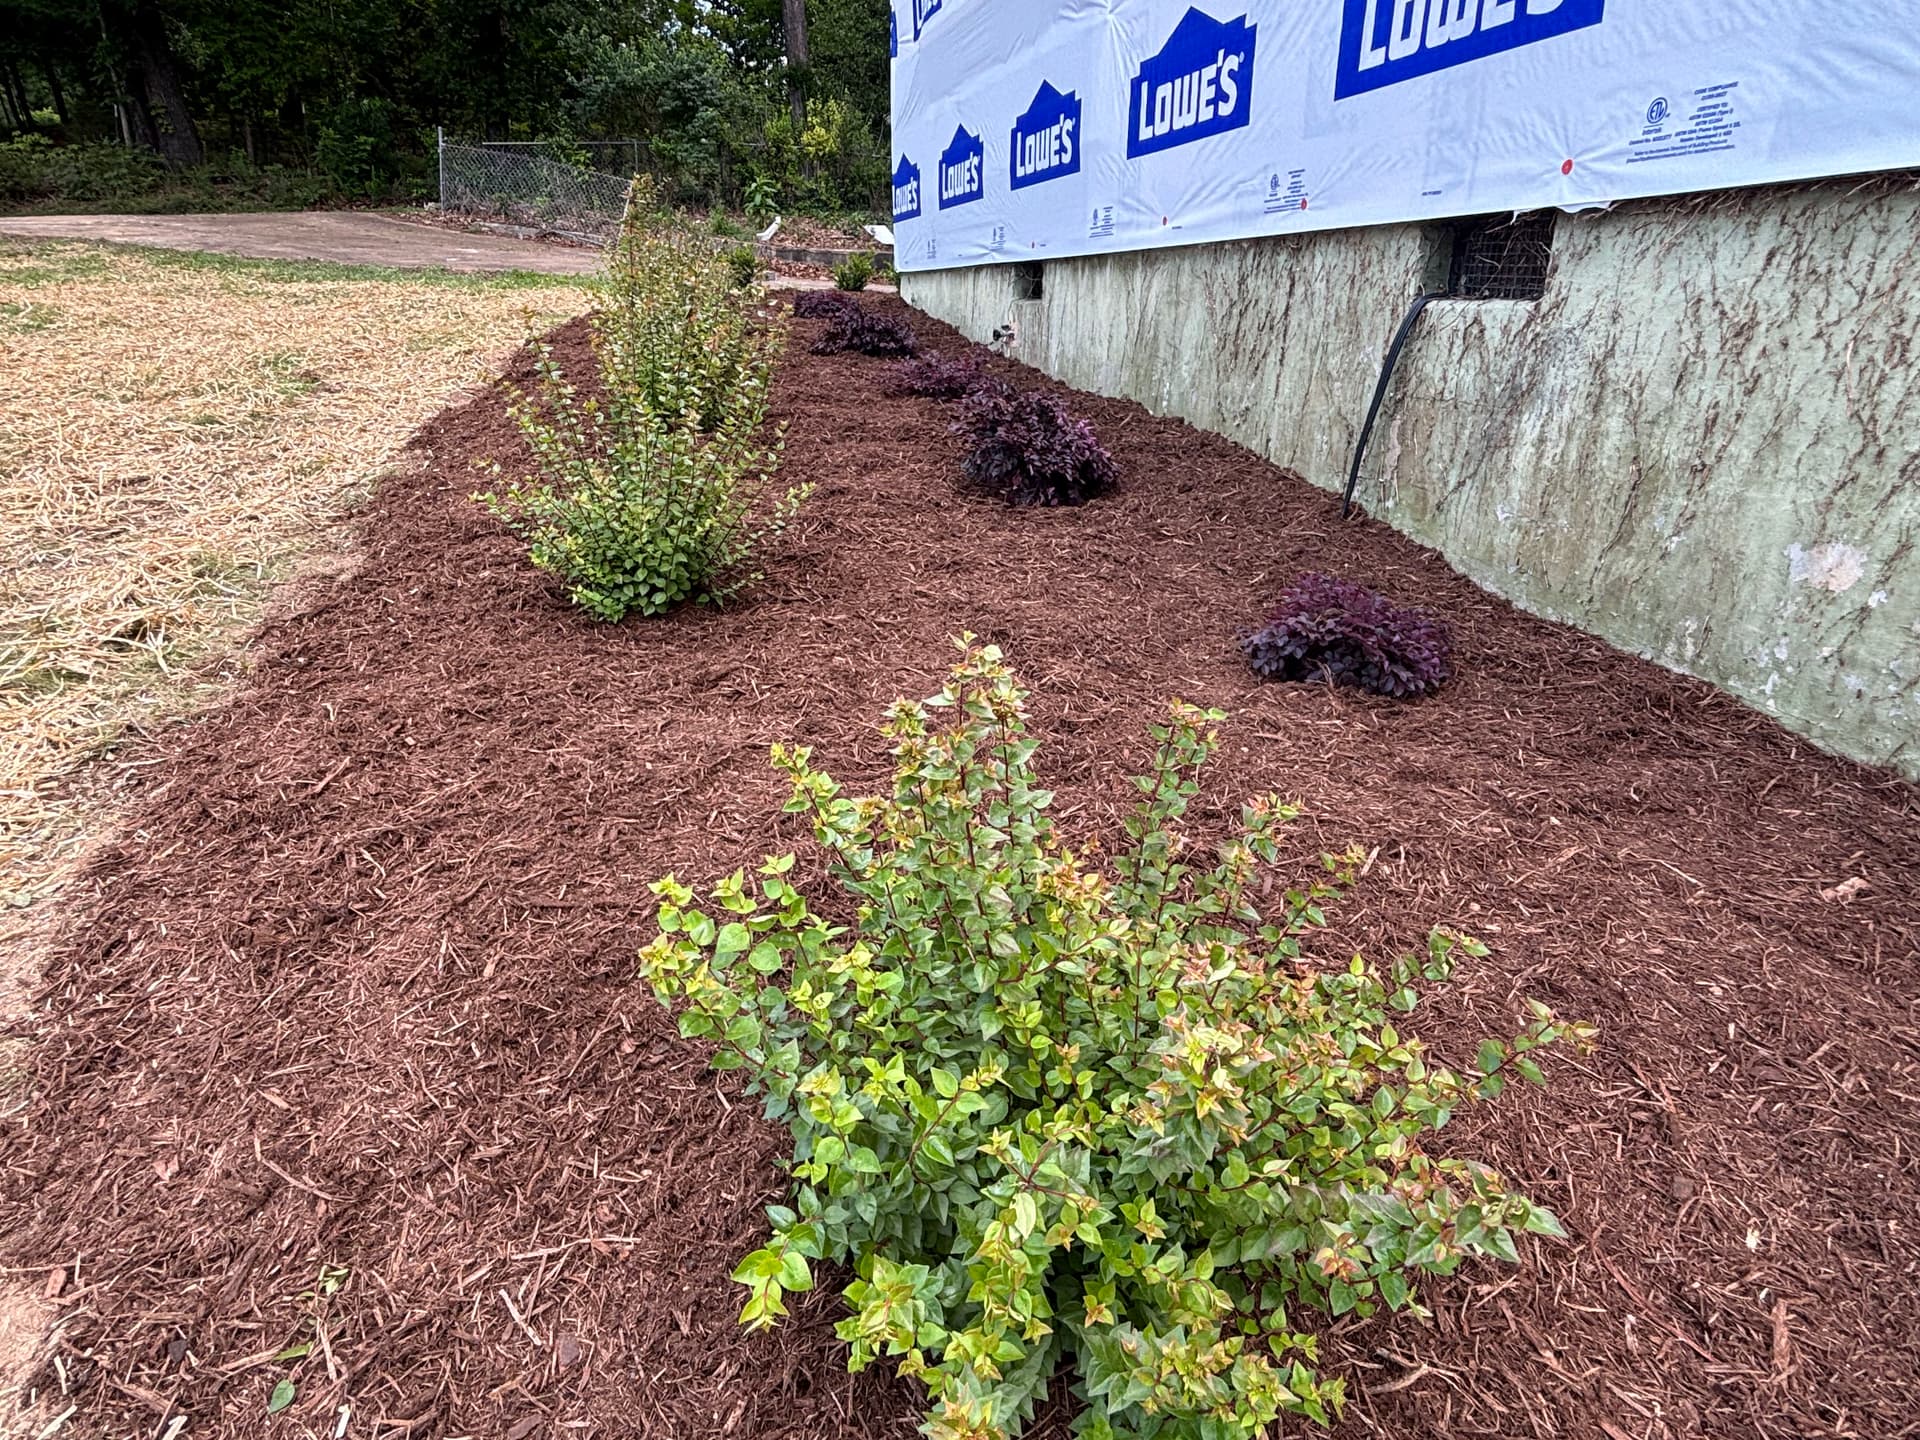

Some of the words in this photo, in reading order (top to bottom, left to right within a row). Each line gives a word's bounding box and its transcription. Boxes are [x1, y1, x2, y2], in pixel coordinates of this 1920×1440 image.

[1138, 48, 1239, 141] LOWE'S
[942, 151, 979, 200] LOWE'S
[1016, 113, 1073, 177] LOWE'S
